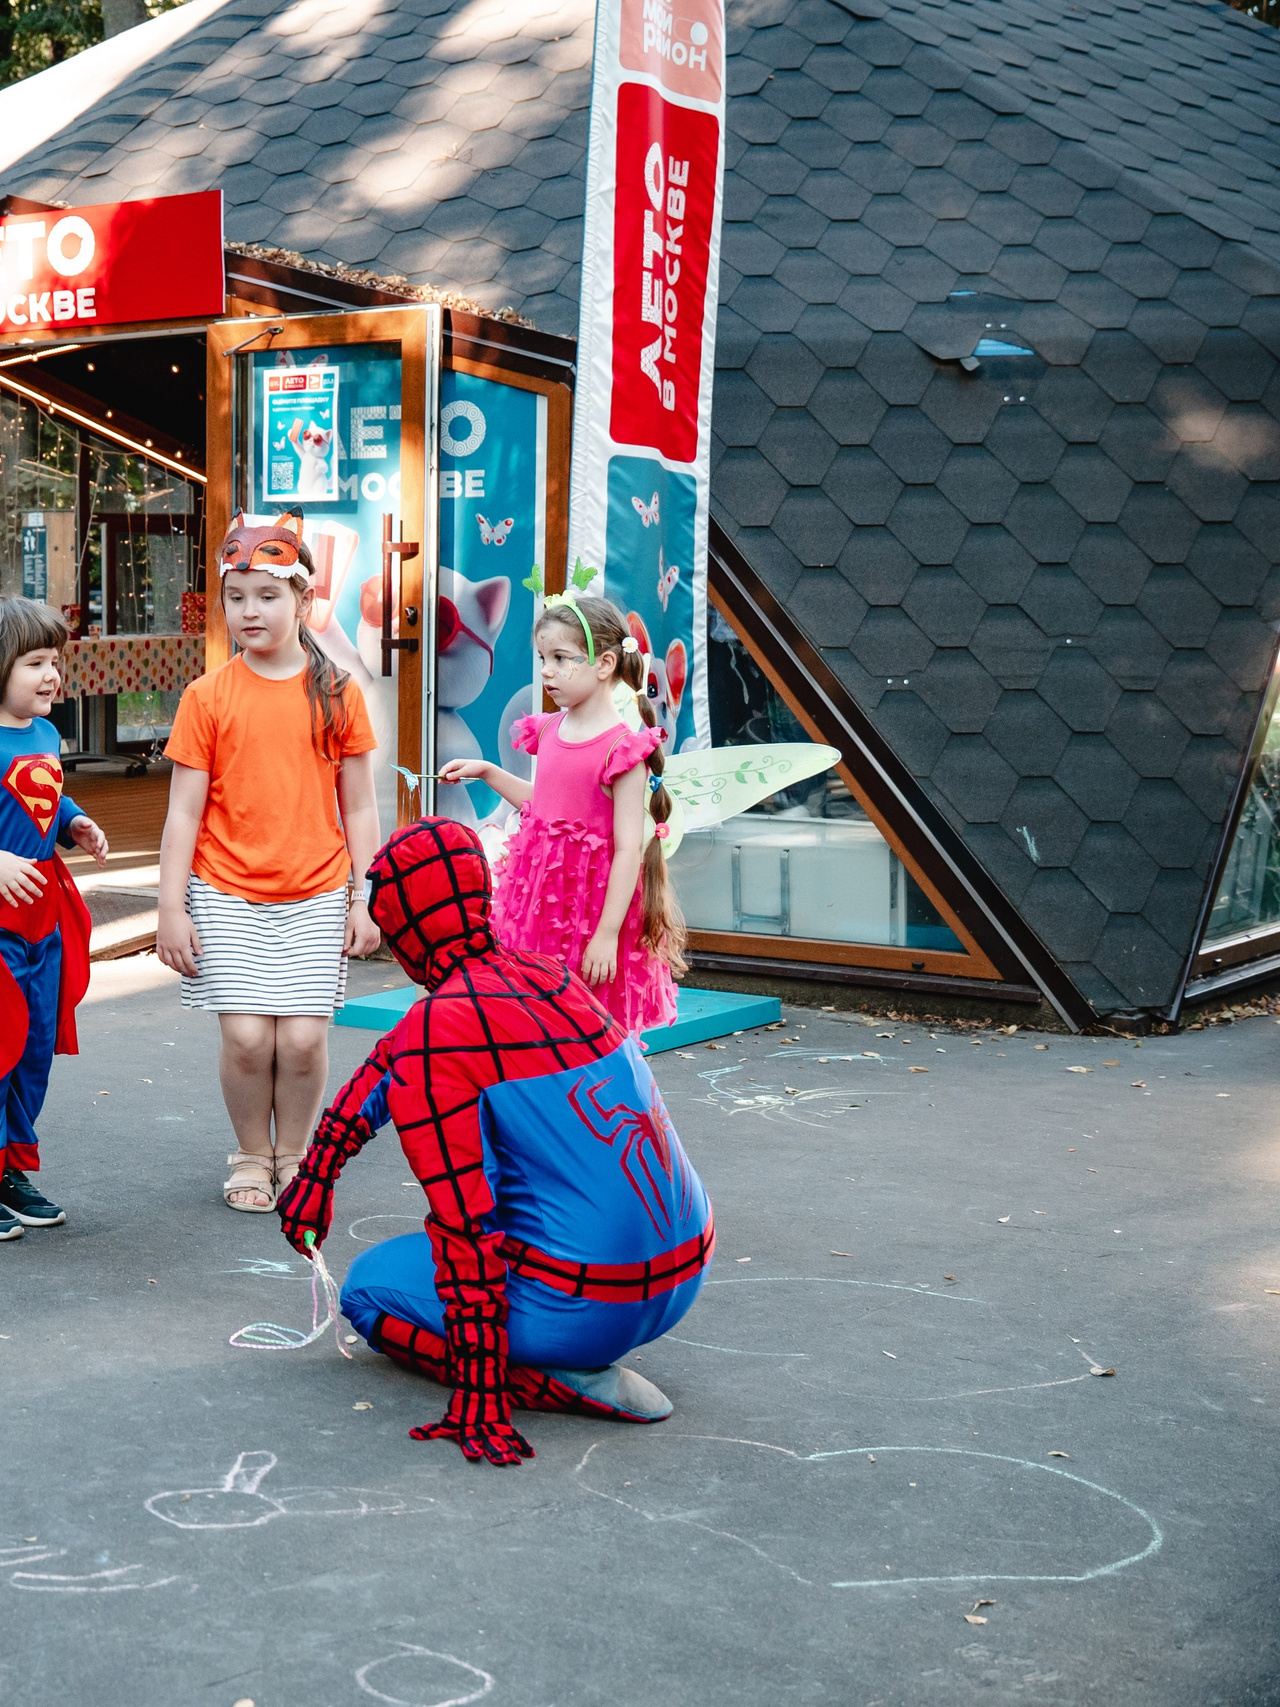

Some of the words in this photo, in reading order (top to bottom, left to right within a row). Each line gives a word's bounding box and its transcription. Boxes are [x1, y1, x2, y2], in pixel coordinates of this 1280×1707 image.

[640, 141, 665, 402] ЛЕТО
[663, 155, 690, 364] МОСКВЕ
[662, 379, 675, 411] В
